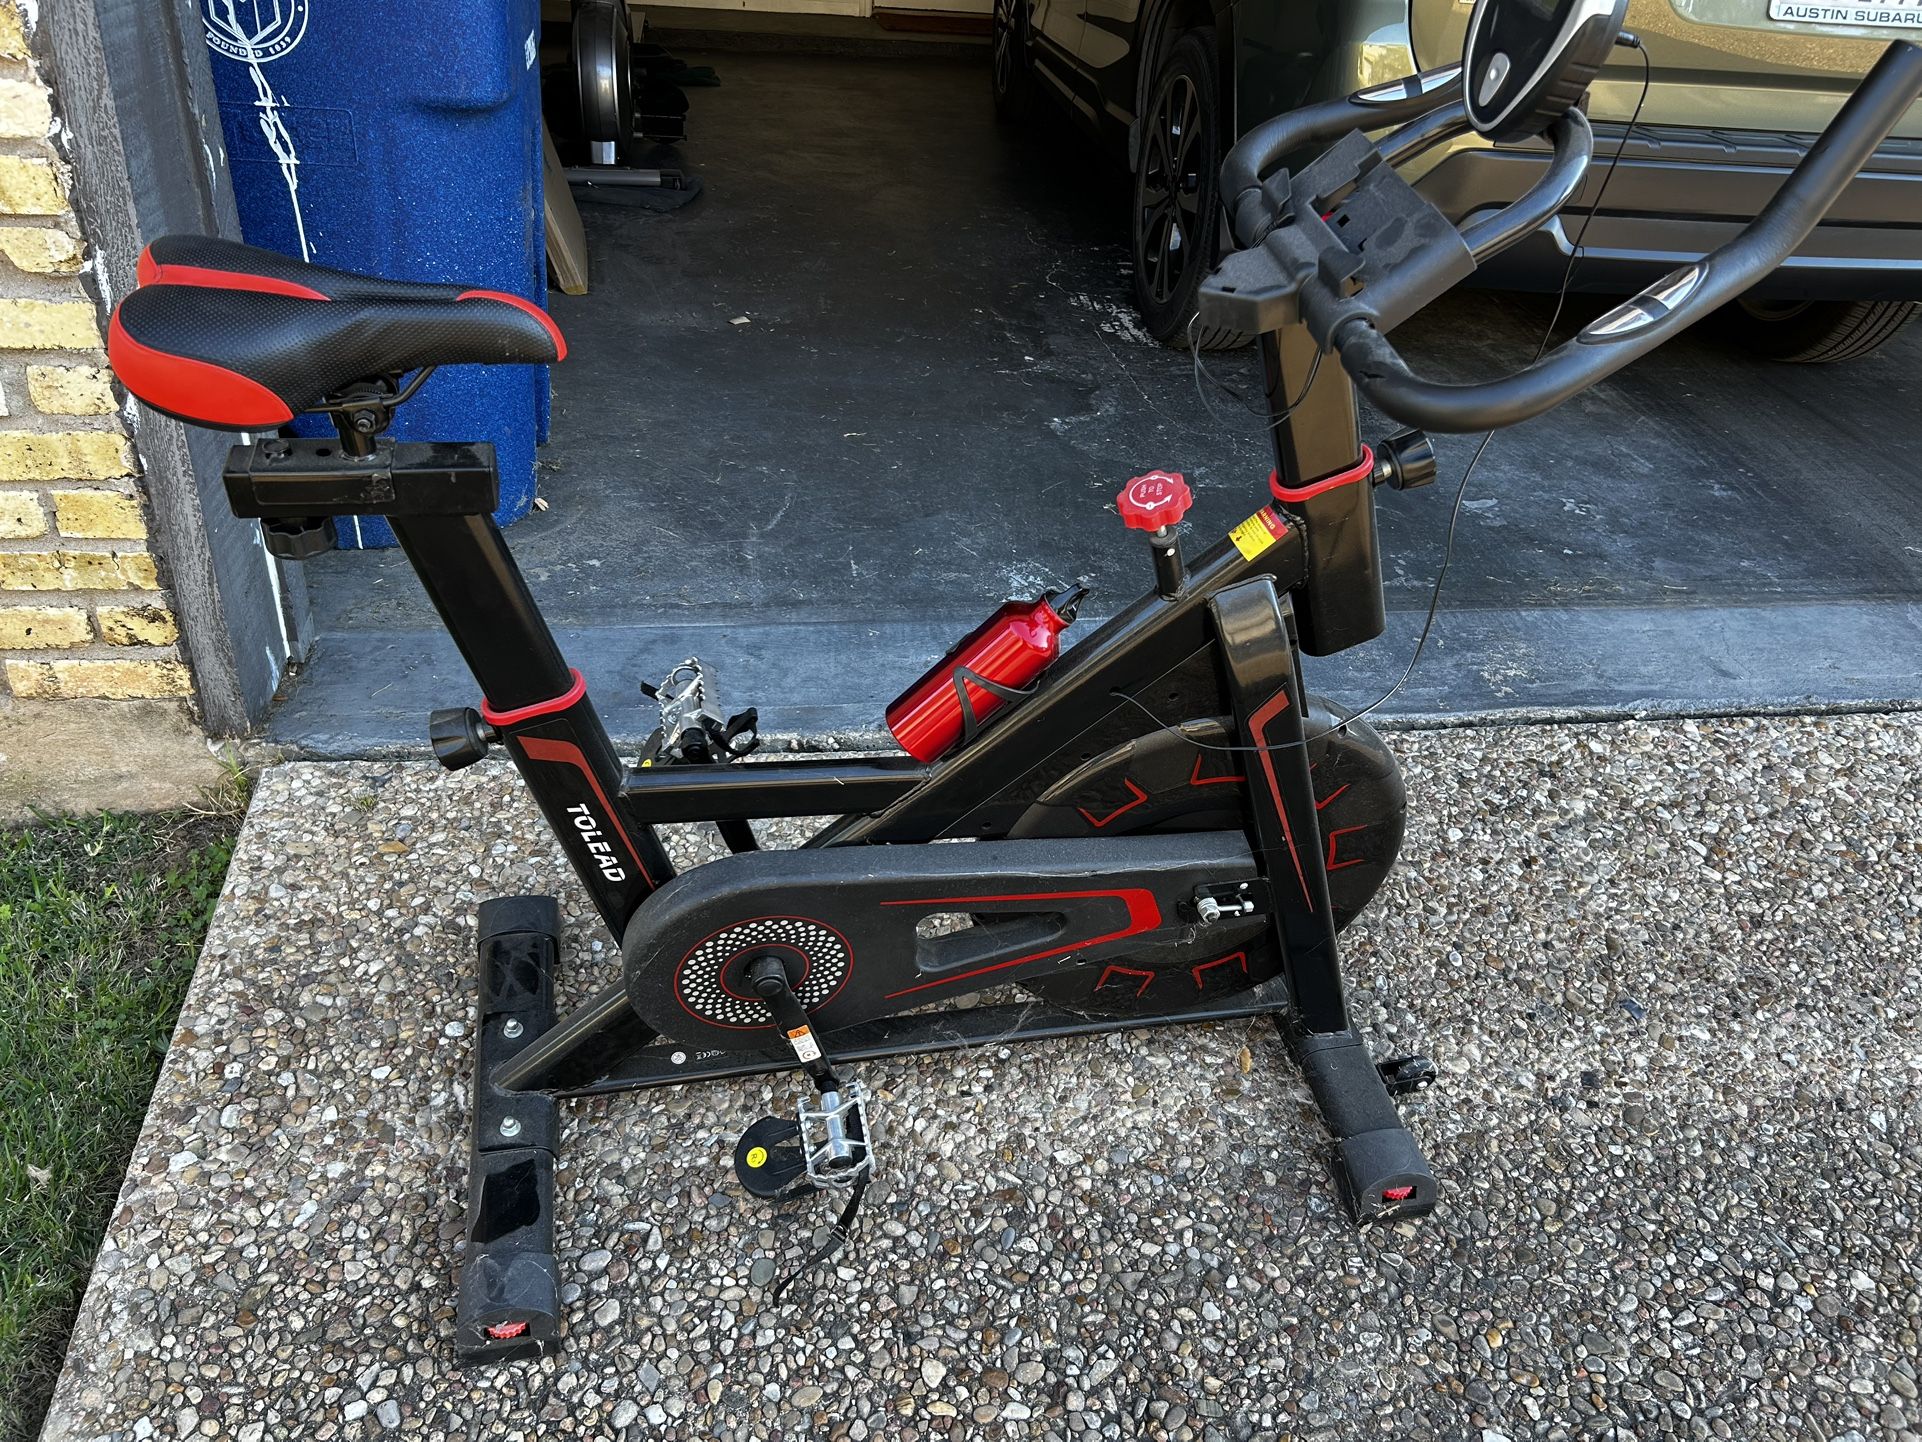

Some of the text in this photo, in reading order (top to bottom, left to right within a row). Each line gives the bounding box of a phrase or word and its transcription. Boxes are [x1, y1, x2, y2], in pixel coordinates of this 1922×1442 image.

[1783, 6, 1848, 20] AUSTIN
[206, 31, 263, 57] FOUNDD
[1148, 485, 1155, 493] TO
[566, 803, 626, 882] TOLEAD
